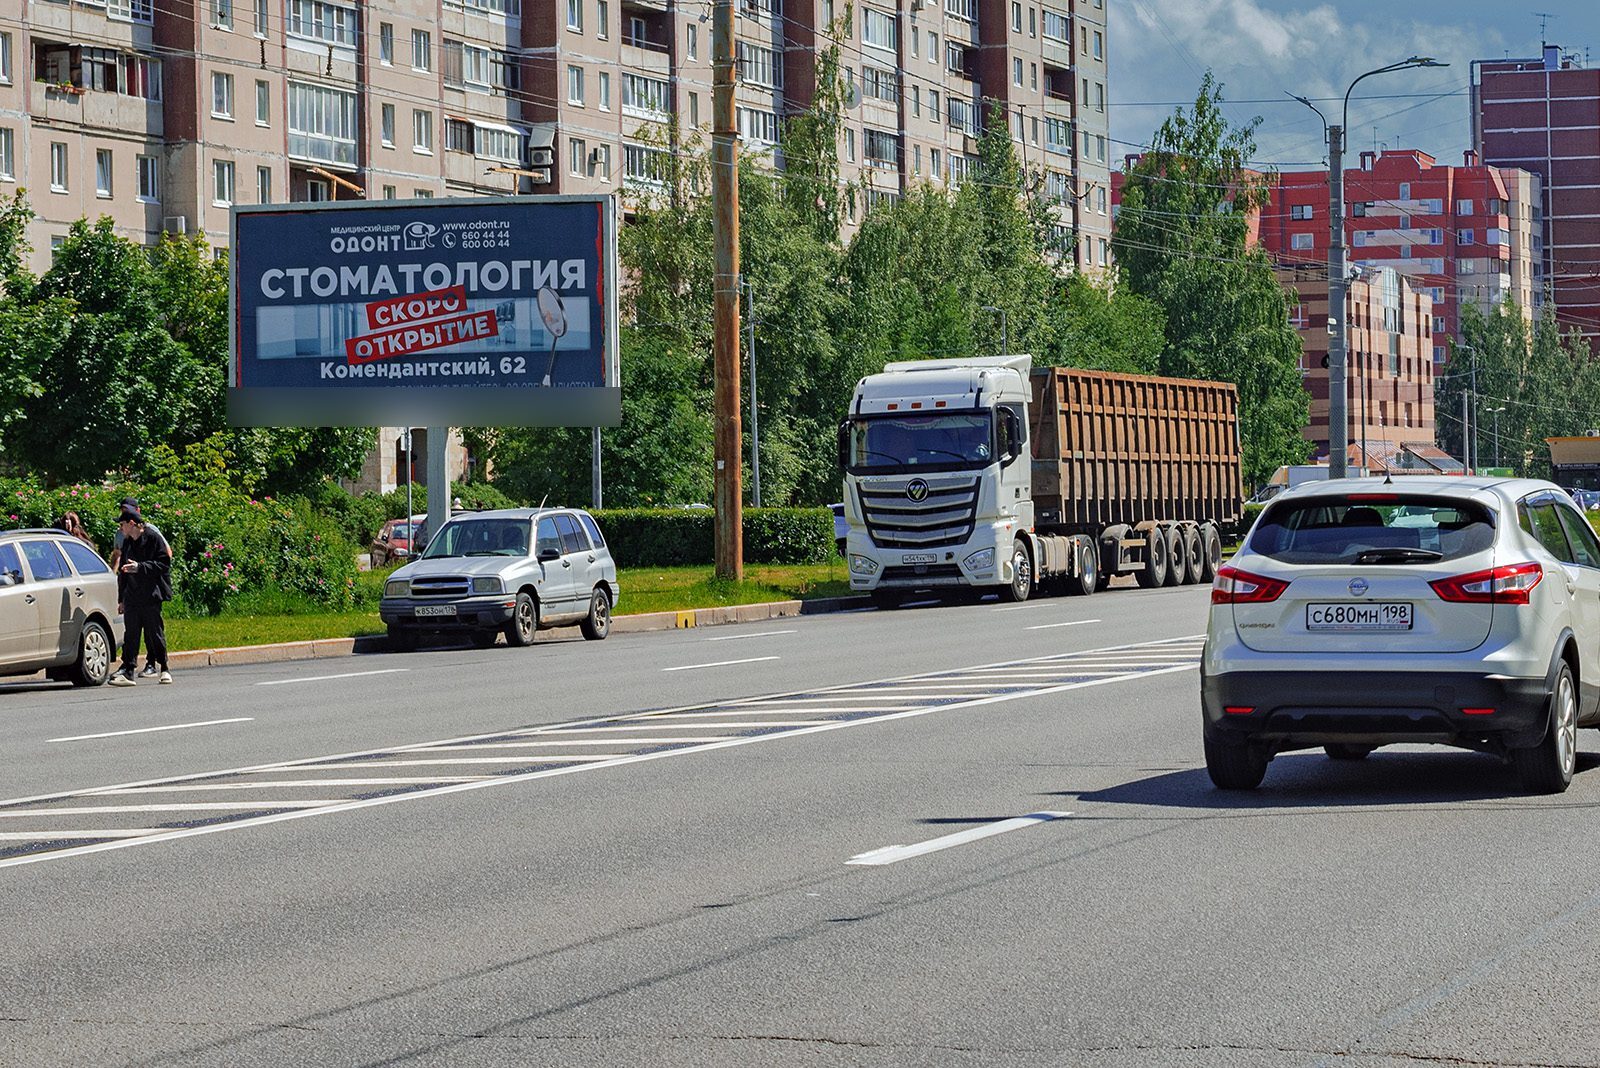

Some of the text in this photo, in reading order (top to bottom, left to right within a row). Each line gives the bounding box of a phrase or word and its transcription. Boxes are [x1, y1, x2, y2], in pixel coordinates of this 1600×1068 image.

[330, 224, 401, 234] МЕДИЦИНСКИЙ ЦЕНТР
[442, 220, 510, 231] www.odont.ru
[461, 230, 510, 240] 660 44 44
[330, 235, 401, 254] ОДОНТ
[462, 239, 510, 249] 600 00 44
[260, 259, 586, 299] СТОМАТОЛОГИЯ
[374, 294, 460, 325] СКОРО
[355, 315, 490, 358] ОТКРЫТИЕ
[320, 356, 526, 379] Комендантский, 62
[1382, 605, 1407, 618] 198
